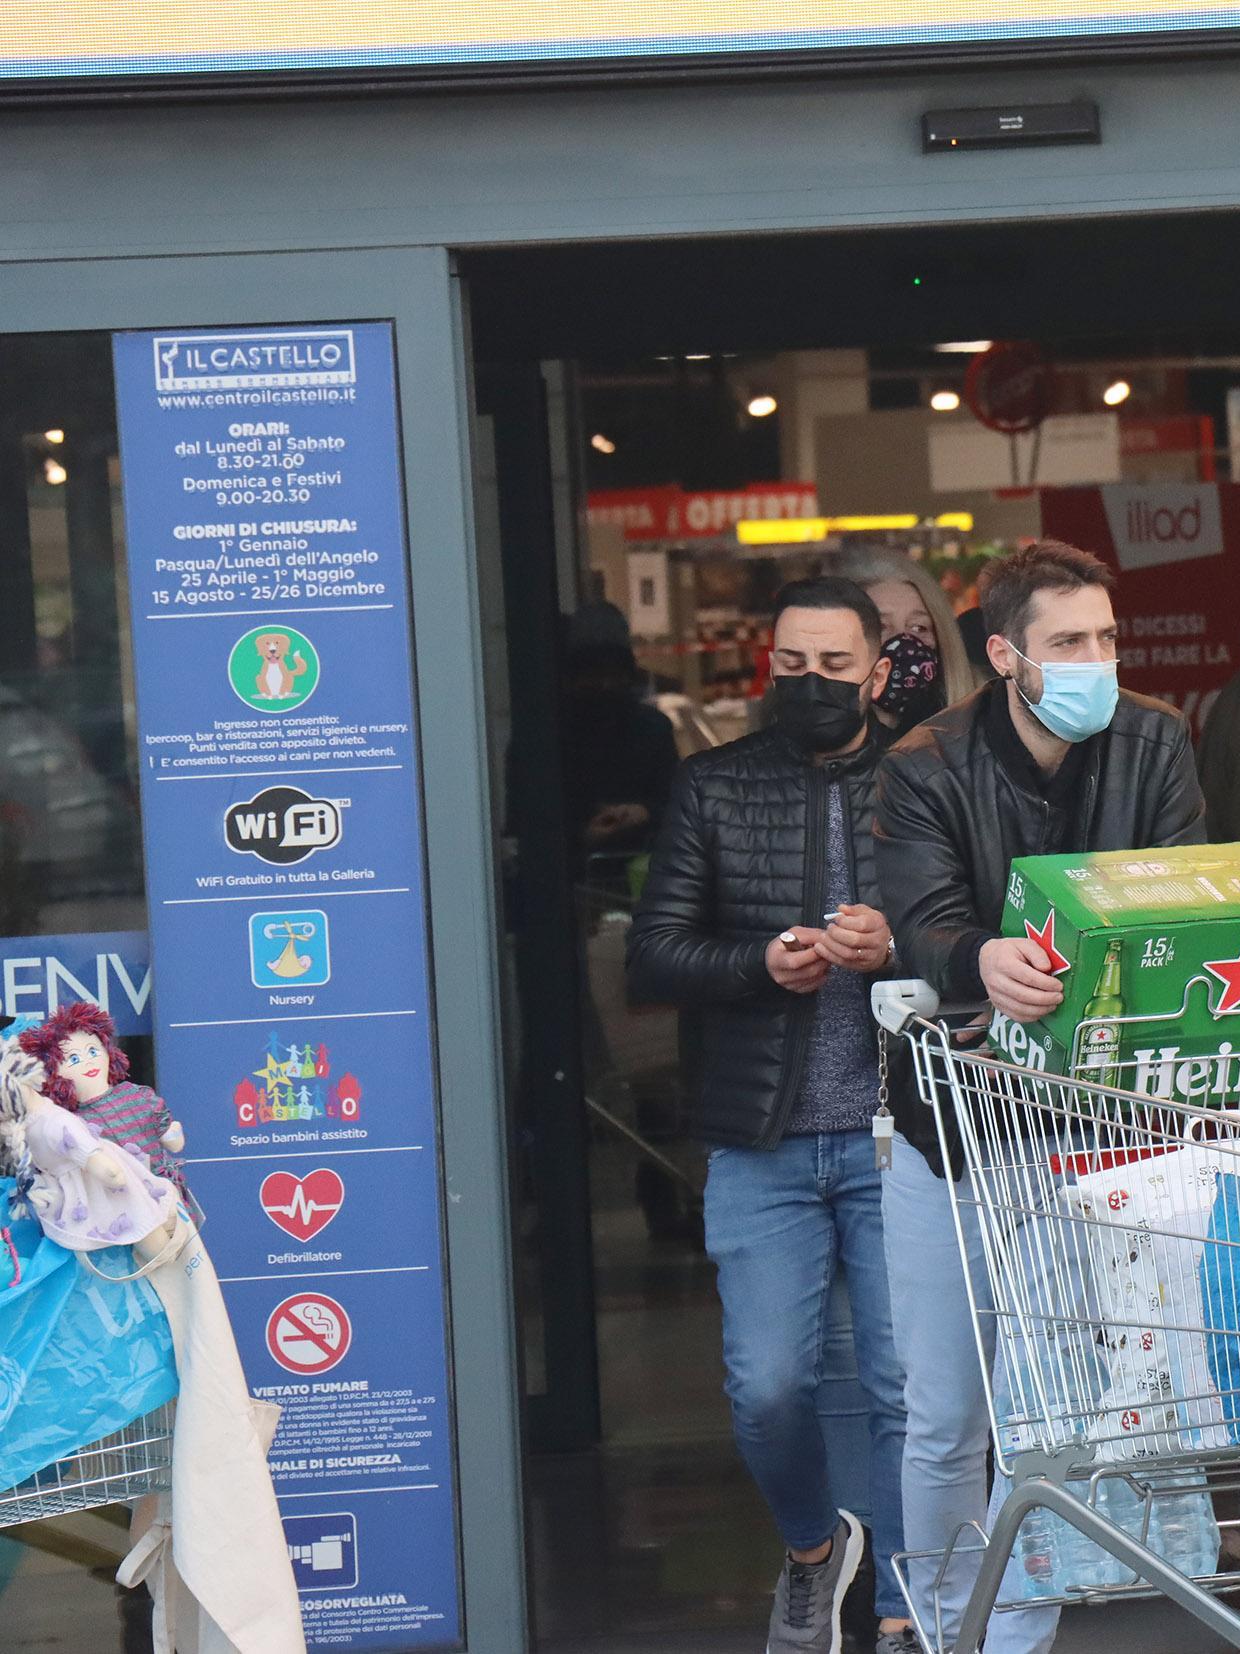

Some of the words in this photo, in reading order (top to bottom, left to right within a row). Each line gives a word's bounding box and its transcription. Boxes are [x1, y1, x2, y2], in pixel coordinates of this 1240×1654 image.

[186, 350, 206, 369] IL
[210, 344, 341, 367] CASTELLO
[158, 387, 356, 408] www.centroilcastello.it
[228, 422, 290, 437] ORARI:
[175, 441, 201, 456] dal
[206, 437, 263, 454] Lunedì
[267, 438, 281, 451] al
[287, 436, 345, 450] Sabato
[183, 475, 267, 492] Domenica
[272, 477, 282, 487] e
[287, 470, 341, 486] Festivi
[216, 488, 310, 506] 9.00-20.30
[173, 523, 235, 540] GIORNI
[239, 523, 258, 537] DI
[261, 518, 357, 536] CHIUSURA:
[1127, 498, 1202, 543] iliad
[219, 539, 234, 553] 1°
[239, 536, 308, 552] Gennaio
[155, 552, 281, 573] Pasqua/Lunedì
[286, 549, 379, 568] dell'Angelo
[181, 573, 202, 587] 25
[207, 571, 257, 589] Aprile
[274, 569, 288, 582] 1°
[294, 566, 355, 584] Maggio
[152, 590, 170, 605] 15
[174, 588, 235, 606] Agosto
[252, 585, 300, 602] 25/26
[306, 581, 385, 599] Dicembre
[214, 720, 258, 731] Ingresso
[260, 718, 280, 728] non
[282, 715, 340, 726] consentito:
[196, 732, 214, 742] bar
[216, 732, 223, 740] e
[225, 727, 285, 740] ristorazioni,
[287, 726, 319, 737] servizi
[322, 724, 358, 737] igienici
[369, 724, 408, 734] nursery.
[189, 742, 216, 752] Punti
[218, 741, 257, 751] vendita
[259, 741, 279, 749] con
[281, 737, 327, 749] apposito
[328, 735, 367, 746] divieto.
[173, 755, 228, 767] consentito
[230, 753, 275, 764] l'accesso
[278, 752, 287, 761] ai
[289, 751, 311, 761] cani
[313, 751, 331, 761] per
[333, 750, 353, 759] non
[355, 746, 396, 757] vedenti.
[196, 875, 224, 887] WiFi
[226, 872, 272, 886] Gratuito
[275, 872, 286, 883] in
[288, 871, 316, 883] tutta
[318, 871, 328, 881] la
[332, 868, 375, 880] Galleria
[1142, 937, 1167, 958] 15
[1140, 958, 1164, 968] PACK
[269, 994, 315, 1006] Nursery
[1080, 1043, 1119, 1054] Heineken
[230, 1134, 269, 1146] Spazio
[272, 1130, 319, 1142] bambini
[321, 1129, 367, 1140] assistito
[267, 1250, 342, 1264] Defibrillatore
[253, 1384, 309, 1397] VIETATO
[312, 1380, 369, 1394] FUMARE
[309, 1458, 323, 1469] DI
[326, 1453, 402, 1468] SICUREZZA
